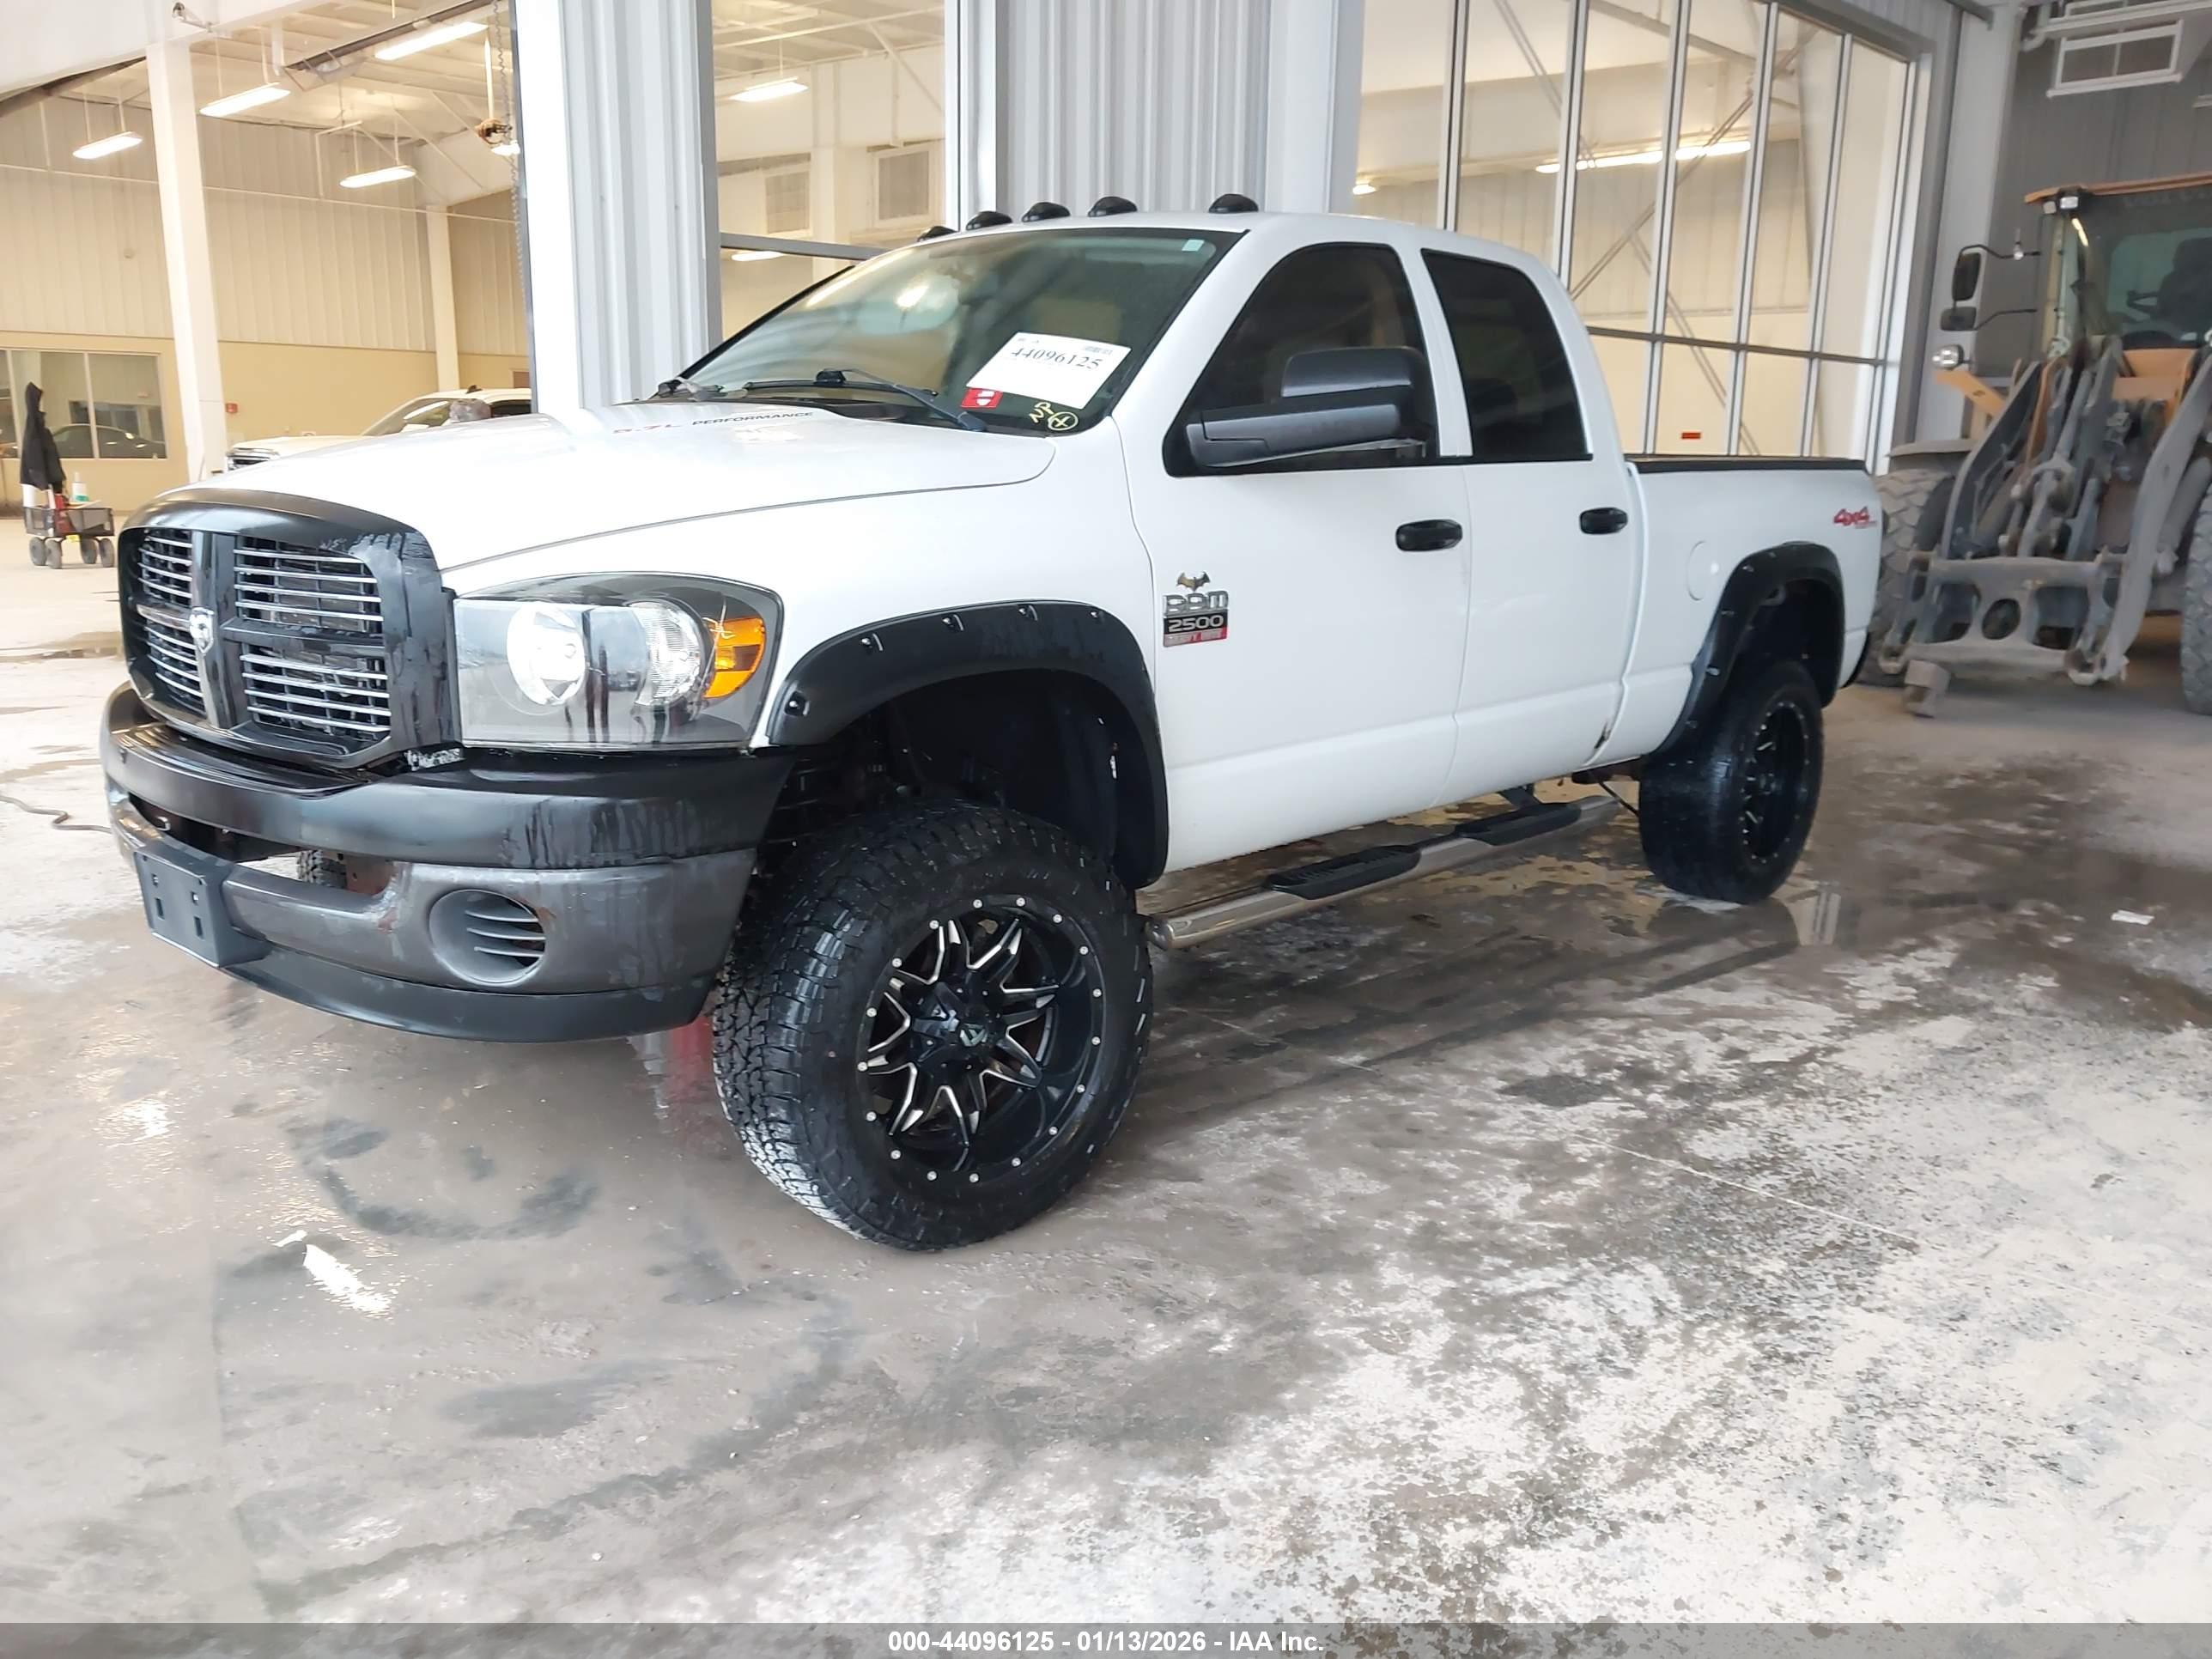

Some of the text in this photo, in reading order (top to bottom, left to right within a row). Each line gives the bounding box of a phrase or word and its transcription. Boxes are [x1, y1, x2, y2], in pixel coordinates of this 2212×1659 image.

[1011, 347, 1103, 369] 44096125
[692, 411, 814, 426] PERFORMANCE
[1169, 615, 1224, 632] 2500
